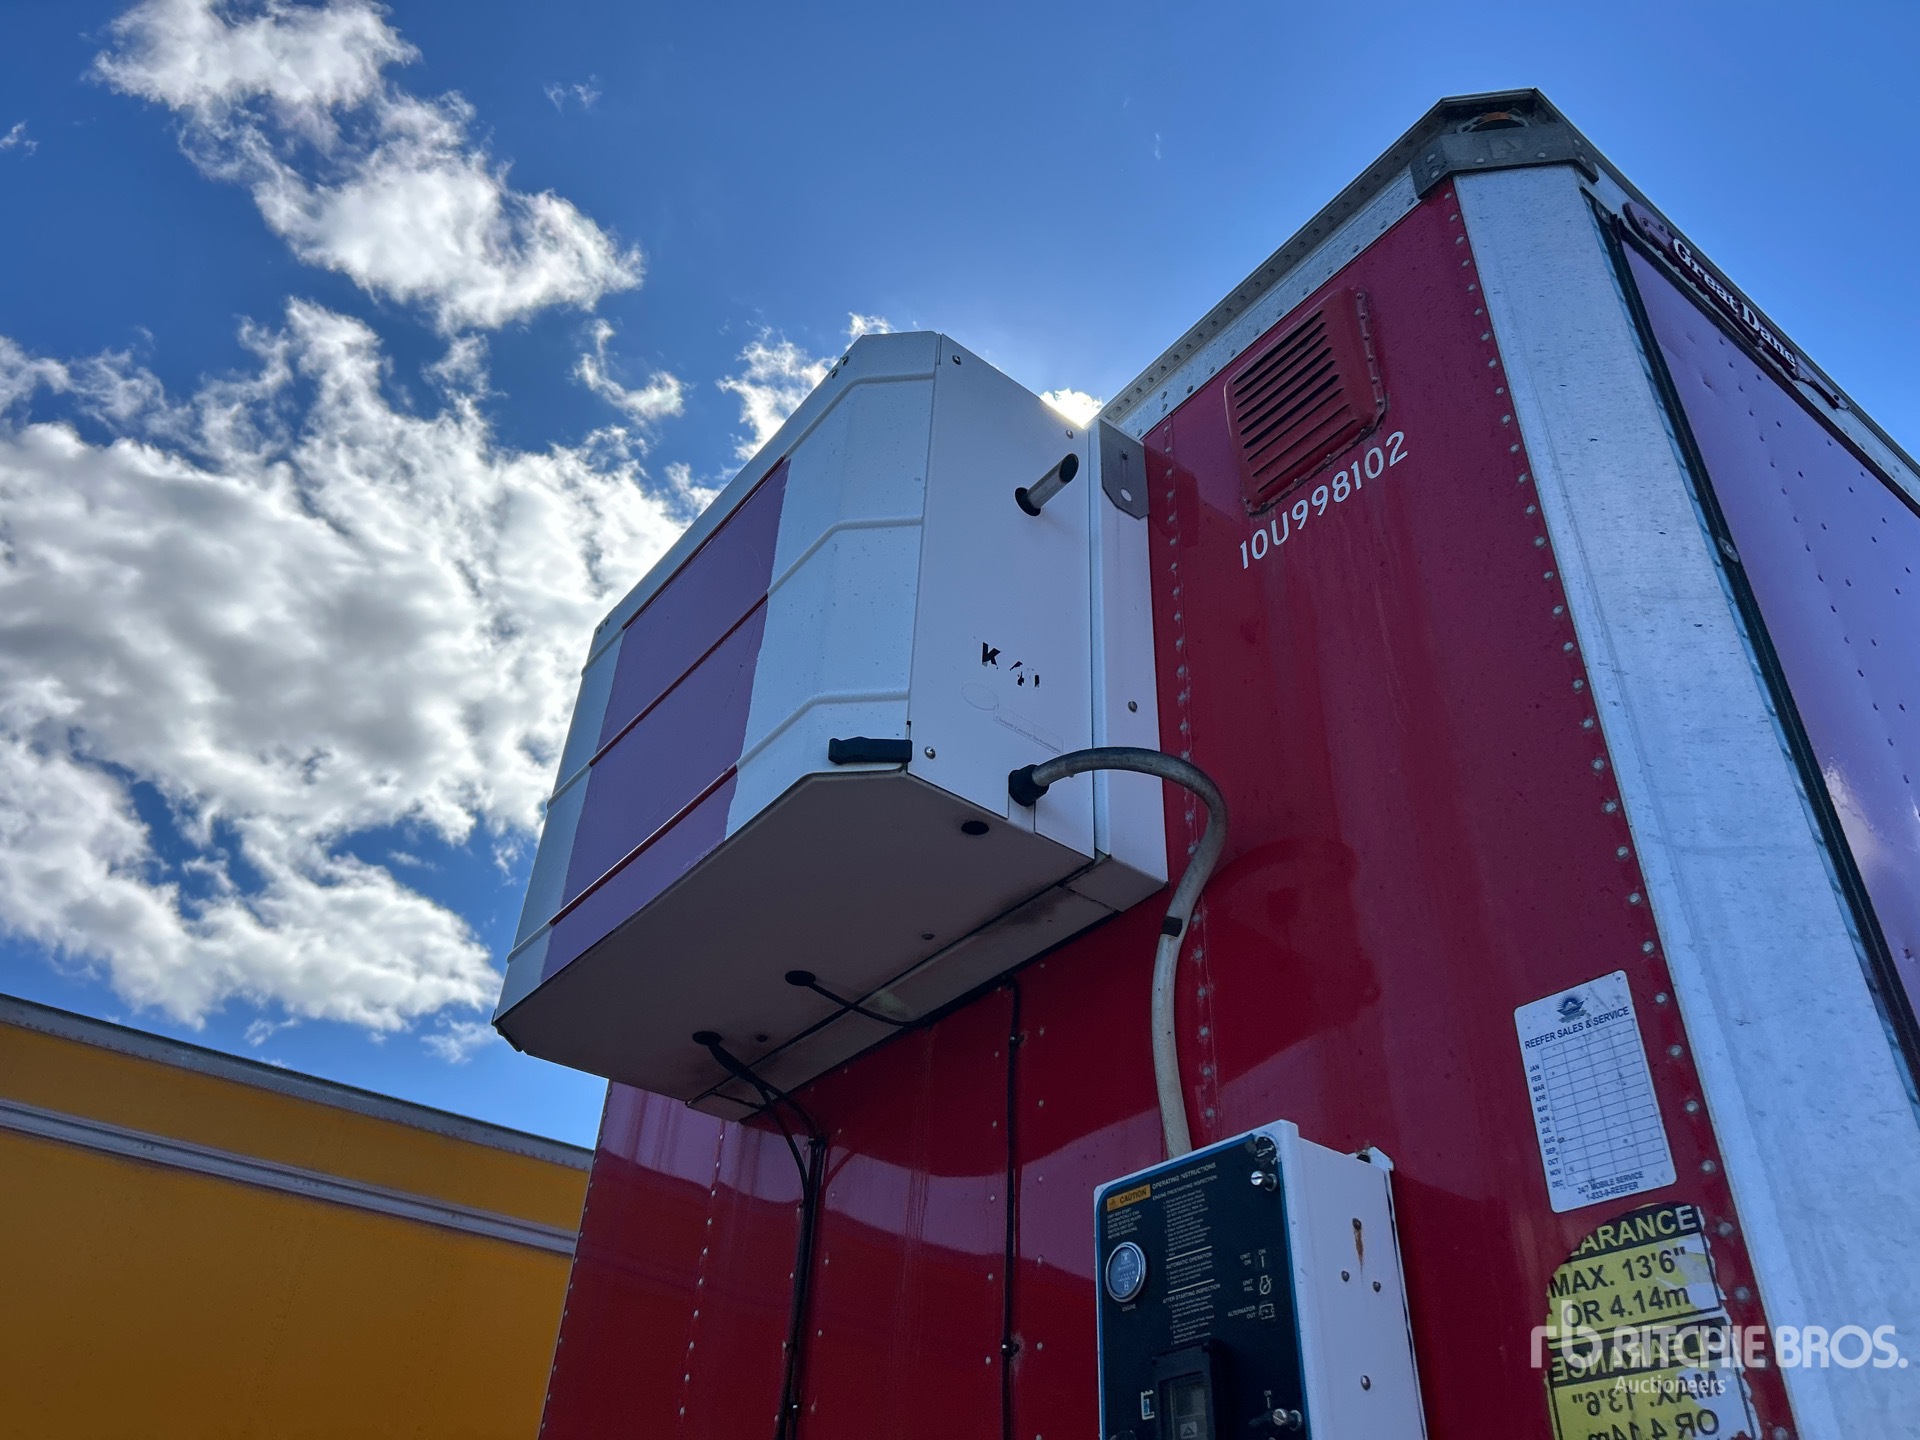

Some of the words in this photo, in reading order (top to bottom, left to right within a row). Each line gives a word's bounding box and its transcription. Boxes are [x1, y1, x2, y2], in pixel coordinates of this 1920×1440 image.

[1673, 238, 1738, 313] Great
[1741, 302, 1796, 367] Dane
[1240, 431, 1408, 570] 10U998102
[1524, 1032, 1556, 1050] REEFER
[1557, 1022, 1584, 1038] SALES
[1585, 1019, 1592, 1029] &
[1593, 1006, 1630, 1026] SERVICE
[1530, 1064, 1540, 1072] JAN
[1531, 1074, 1542, 1083] FEB
[1533, 1083, 1545, 1093] MAR
[1535, 1094, 1546, 1103] APR
[1537, 1104, 1548, 1113] MAY
[1539, 1116, 1550, 1124] JUN
[1541, 1126, 1551, 1134] JUL
[1544, 1135, 1556, 1146] AUG
[1547, 1157, 1559, 1166] OCT
[1550, 1168, 1561, 1176] NOV
[1615, 1170, 1644, 1184] SERVICE
[1152, 1175, 1180, 1189] OPERATING
[1551, 1179, 1564, 1189] DEC
[1120, 1188, 1147, 1204] CAUTION
[1570, 1204, 1697, 1256] ARANCE
[1550, 1264, 1615, 1298] MAX.
[1563, 1299, 1604, 1328] OR
[1610, 1286, 1690, 1318] 4.14m
